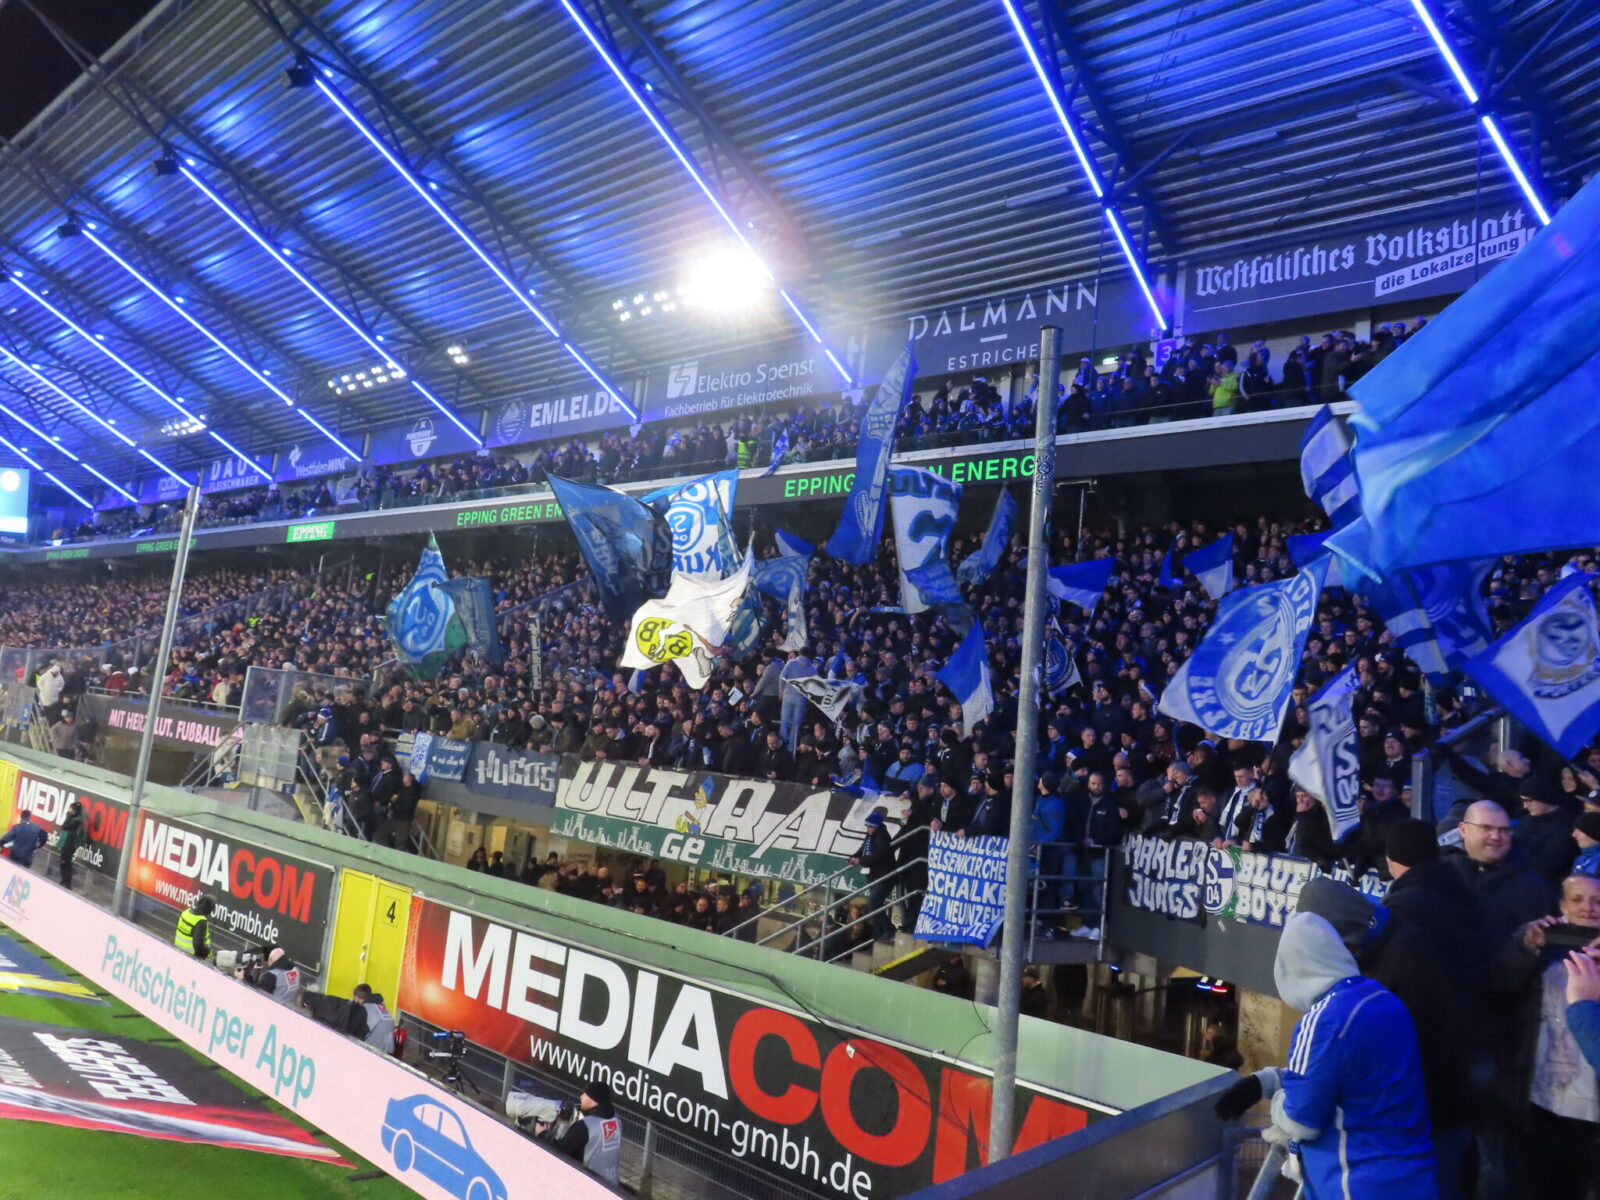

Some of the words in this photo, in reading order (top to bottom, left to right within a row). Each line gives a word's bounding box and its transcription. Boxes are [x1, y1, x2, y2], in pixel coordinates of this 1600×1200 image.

[1380, 274, 1405, 291] die
[1410, 235, 1520, 279] Lokalzetung
[907, 279, 1099, 341] DALMANN
[947, 343, 1040, 371] ESTRICHE
[1161, 345, 1172, 361] 3
[697, 371, 751, 394] Elektro
[756, 358, 815, 387] Spenst
[530, 389, 622, 428] EMLEI.DE
[664, 400, 719, 417] Fachbetrieb
[720, 398, 733, 410] für
[737, 384, 813, 405] Elektrotechnik
[951, 455, 1037, 482] ENERG
[784, 473, 856, 498] EPPING
[456, 509, 498, 526] EPPING
[500, 505, 542, 523] GREEN
[292, 524, 329, 541] EPPING
[108, 709, 125, 729] MIT
[929, 829, 1010, 860] FUSSBALLCLU
[139, 818, 316, 923] MEDIACOM
[928, 848, 1009, 882] GELSENKIRCHE
[1206, 885, 1220, 905] 04
[386, 901, 396, 923] 4
[102, 934, 207, 1034] Parkschein
[208, 1007, 254, 1054] per
[256, 1023, 316, 1108] App
[441, 910, 1089, 1185] MEDIACOM
[529, 1035, 873, 1200] www.mediacom-gmbh.de
